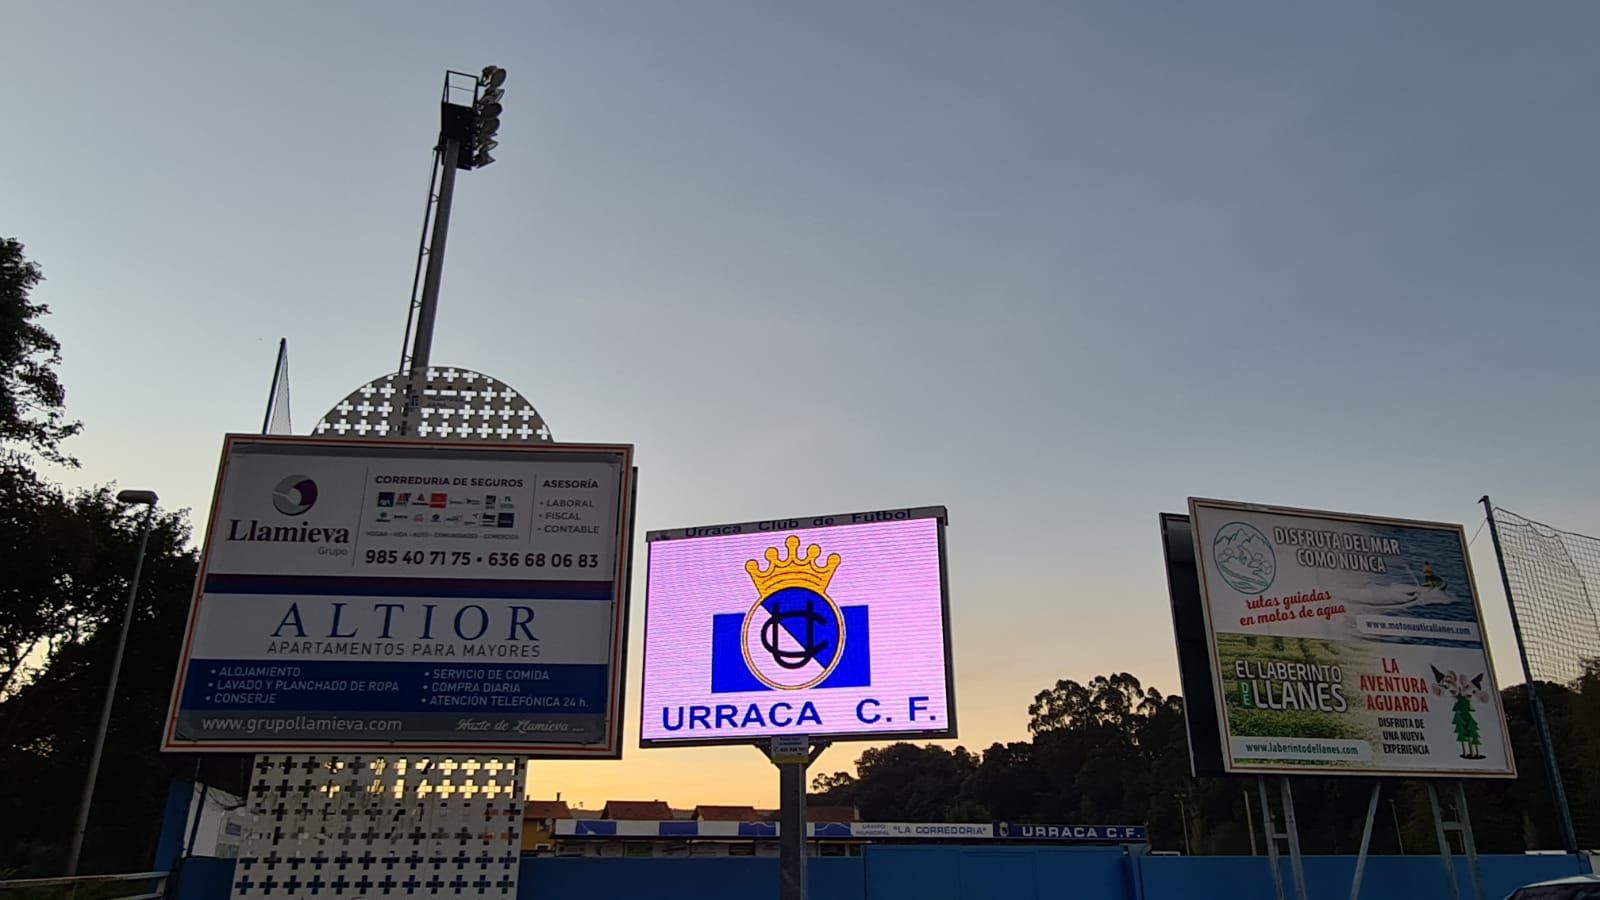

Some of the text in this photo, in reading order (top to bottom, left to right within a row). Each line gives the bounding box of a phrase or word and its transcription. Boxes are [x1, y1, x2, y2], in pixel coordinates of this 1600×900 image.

[376, 476, 524, 488] CORREDURIA DE SEGUROS
[543, 478, 599, 488] ASESORÍA
[546, 500, 594, 508] LABORAL
[545, 512, 581, 520] FISCAL
[544, 525, 600, 534] CONTABLE
[685, 509, 912, 538] Urraca Club de Futbol
[227, 520, 348, 544] Llamieva
[1273, 527, 1401, 556] DISFRUTA DEL MAR
[318, 546, 348, 556] Grupo
[366, 550, 598, 568] 985 40 71 75 636 68 06 83
[1296, 549, 1387, 574] COMO NUNCA
[1246, 589, 1331, 610] rutas guiadas
[270, 602, 541, 641] ALTIOR
[1240, 605, 1346, 626] en motos de agua
[266, 640, 541, 658] APARTAMENTOS PARA MAYORES
[218, 666, 301, 678] ALOJAMIENTO
[1235, 660, 1342, 682] EL LABERINTO
[1382, 658, 1400, 674] LA
[432, 669, 550, 680] SERVICIO DE COMIDA
[217, 680, 400, 692] LAVADO Y PLANCHADO DE ROPA
[432, 682, 520, 693] COMPRA DIARIA
[1360, 675, 1428, 694] AVENTURA
[214, 693, 278, 704] CONSERJE
[430, 693, 488, 706] ATENCIÓN
[563, 698, 576, 708] 24
[578, 698, 589, 708] h.
[1252, 680, 1348, 712] LLANES
[1366, 694, 1430, 712] AGUARDA
[662, 700, 822, 732] URRACA
[908, 696, 937, 722] F.
[202, 716, 402, 734] www.grupollamieva.com
[493, 720, 509, 730] de
[512, 720, 568, 734] Llamieva
[1378, 717, 1424, 729] DISFRUTA DE
[1382, 730, 1424, 742] UNA NUEVA
[1246, 742, 1359, 754] www.laberintodellanes.com
[1383, 744, 1430, 755] EXPERIENCIA
[892, 826, 986, 835] "LA CORREDORIA"
[1022, 826, 1098, 838] URRACA
